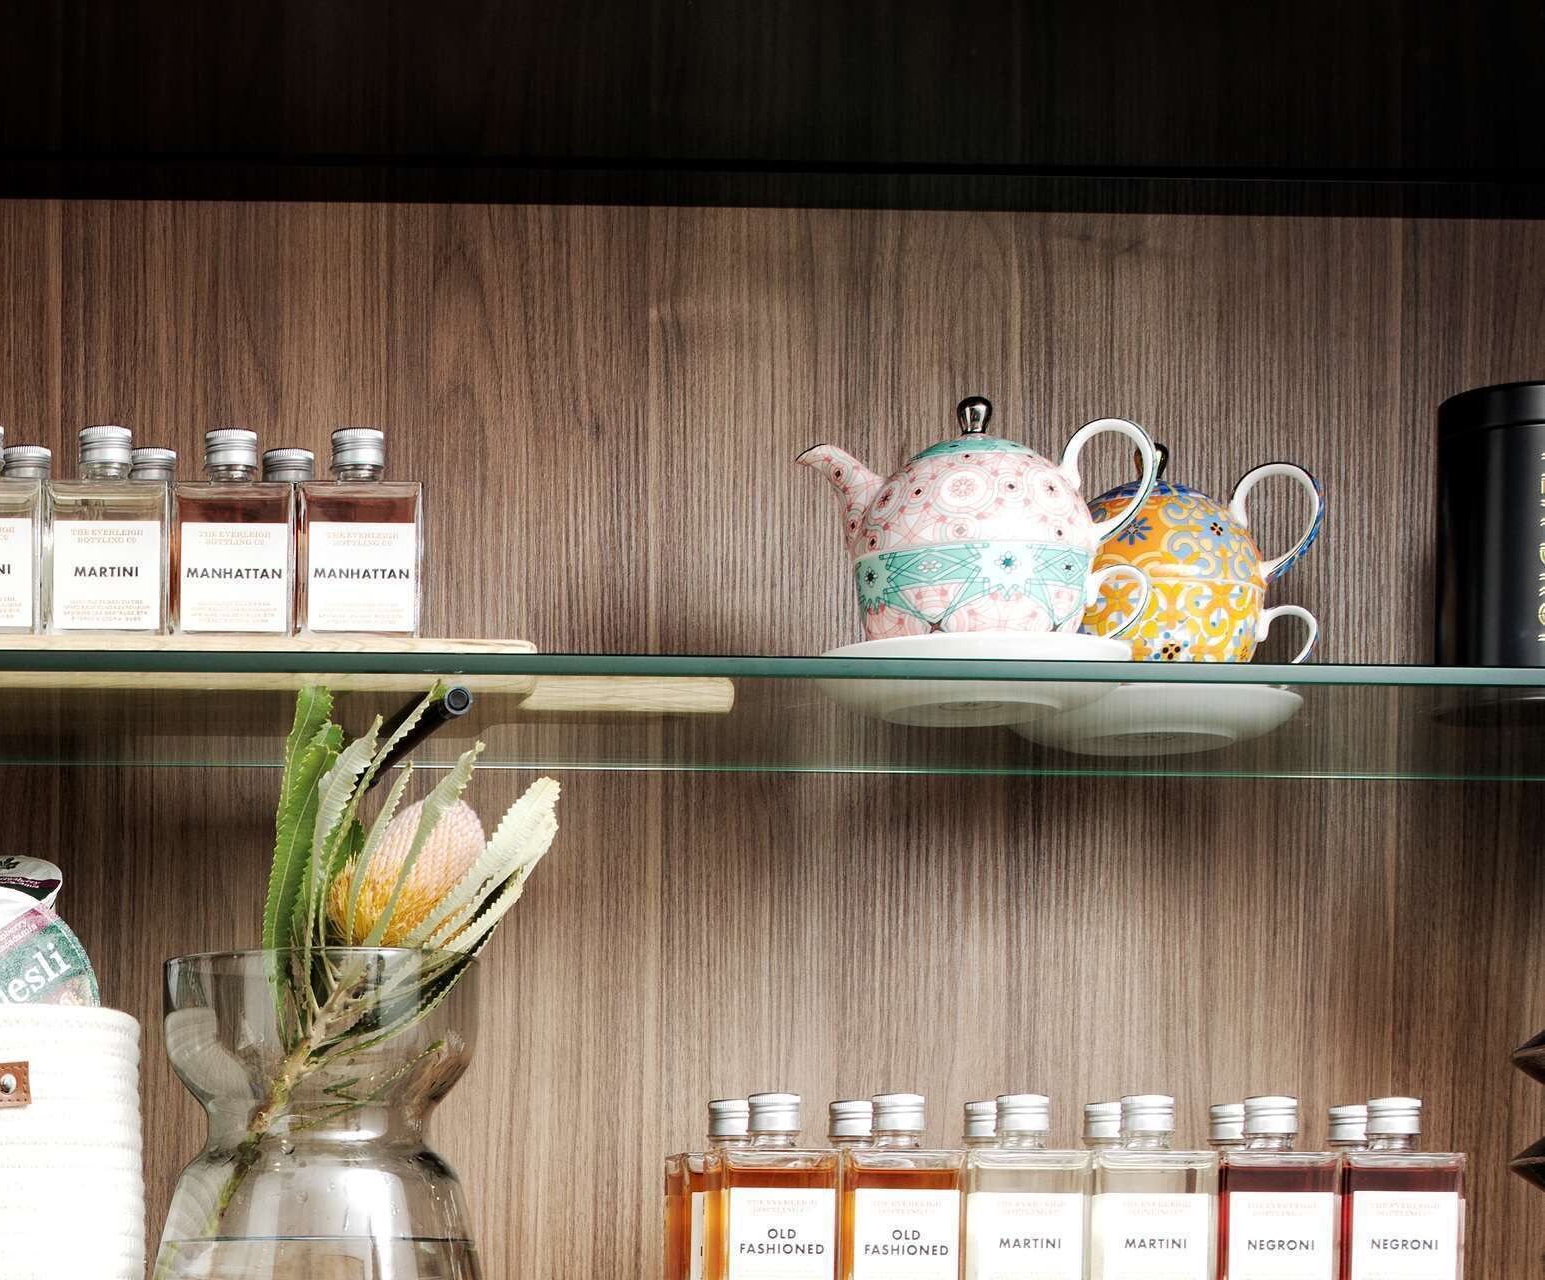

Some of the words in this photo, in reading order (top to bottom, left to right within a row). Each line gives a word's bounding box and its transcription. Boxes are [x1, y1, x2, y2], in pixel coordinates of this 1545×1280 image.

[73, 566, 139, 578] MARTINI
[186, 567, 283, 580] MANHATTAN
[313, 568, 410, 580] MANHATTAN
[767, 1228, 797, 1240] OLD
[892, 1230, 921, 1240] OLD
[999, 1238, 1061, 1248] MARTINI
[1125, 1238, 1187, 1249] MARTINI
[1247, 1240, 1315, 1250] NEGRONI
[1371, 1239, 1439, 1250] NEGRONI
[739, 1244, 825, 1255] FASHIONED
[865, 1244, 949, 1256] FASHIONED
